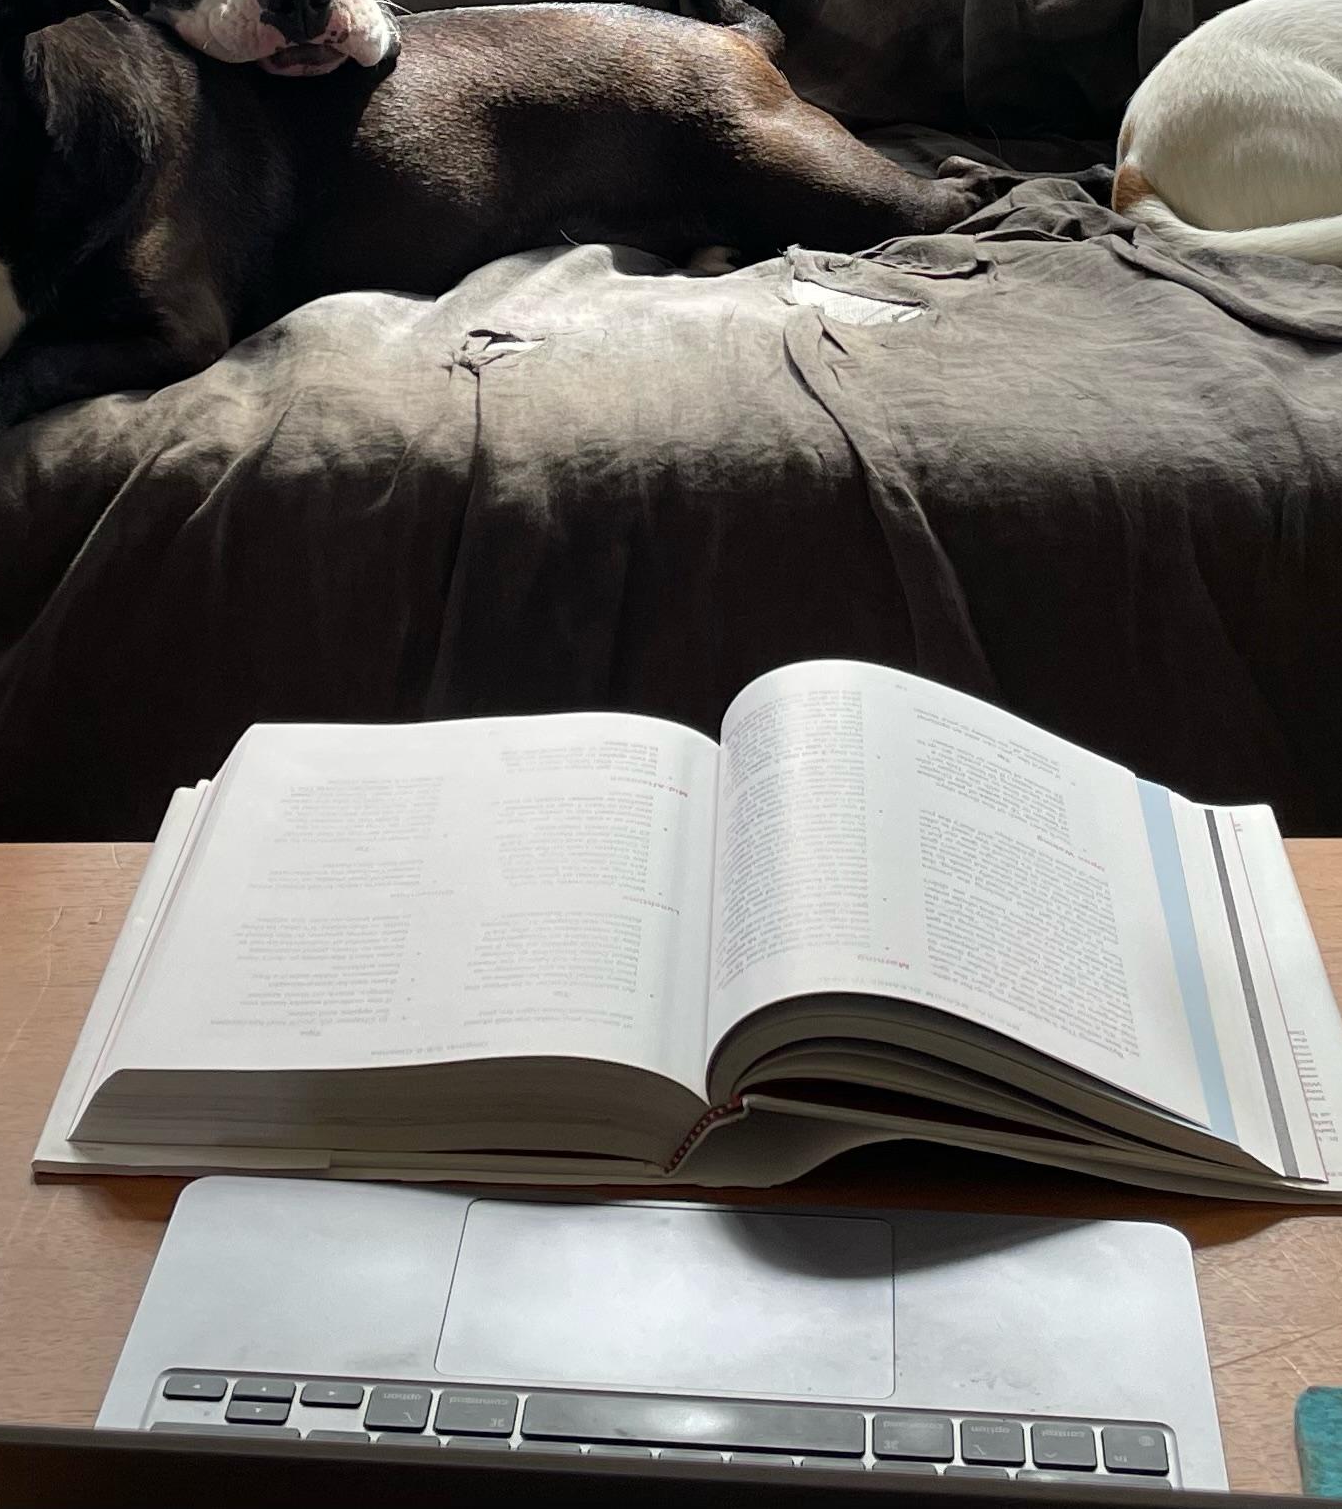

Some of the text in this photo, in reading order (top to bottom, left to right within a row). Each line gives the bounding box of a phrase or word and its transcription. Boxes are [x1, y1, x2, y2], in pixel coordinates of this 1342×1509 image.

[856, 954, 910, 971] Morning
[383, 1392, 422, 1402] option
[449, 1396, 509, 1407] command
[970, 1424, 1011, 1436] option
[1041, 1428, 1086, 1439] control
